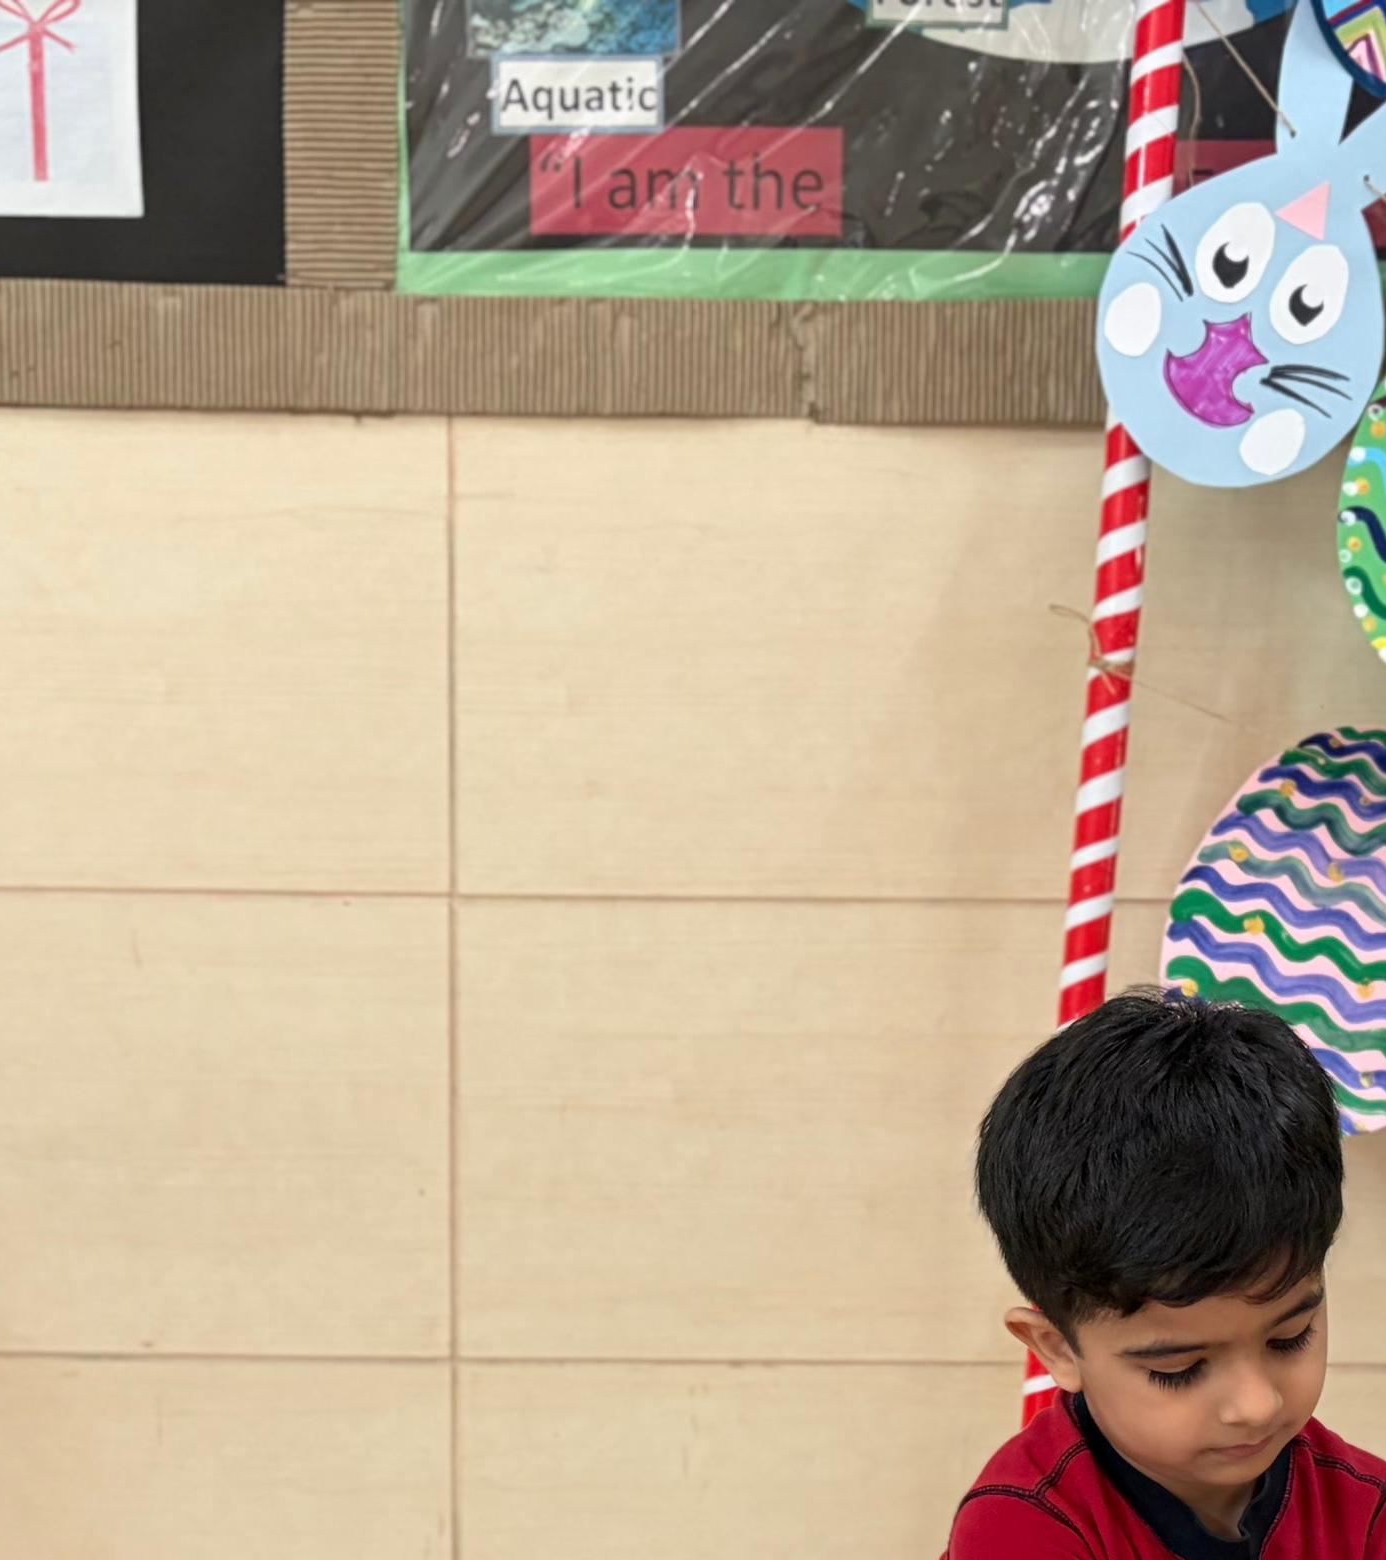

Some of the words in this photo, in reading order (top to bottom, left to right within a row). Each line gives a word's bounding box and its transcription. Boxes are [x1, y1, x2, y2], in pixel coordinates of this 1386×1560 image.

[501, 77, 656, 121] Aquatic
[608, 168, 701, 210] am
[723, 155, 825, 210] the
